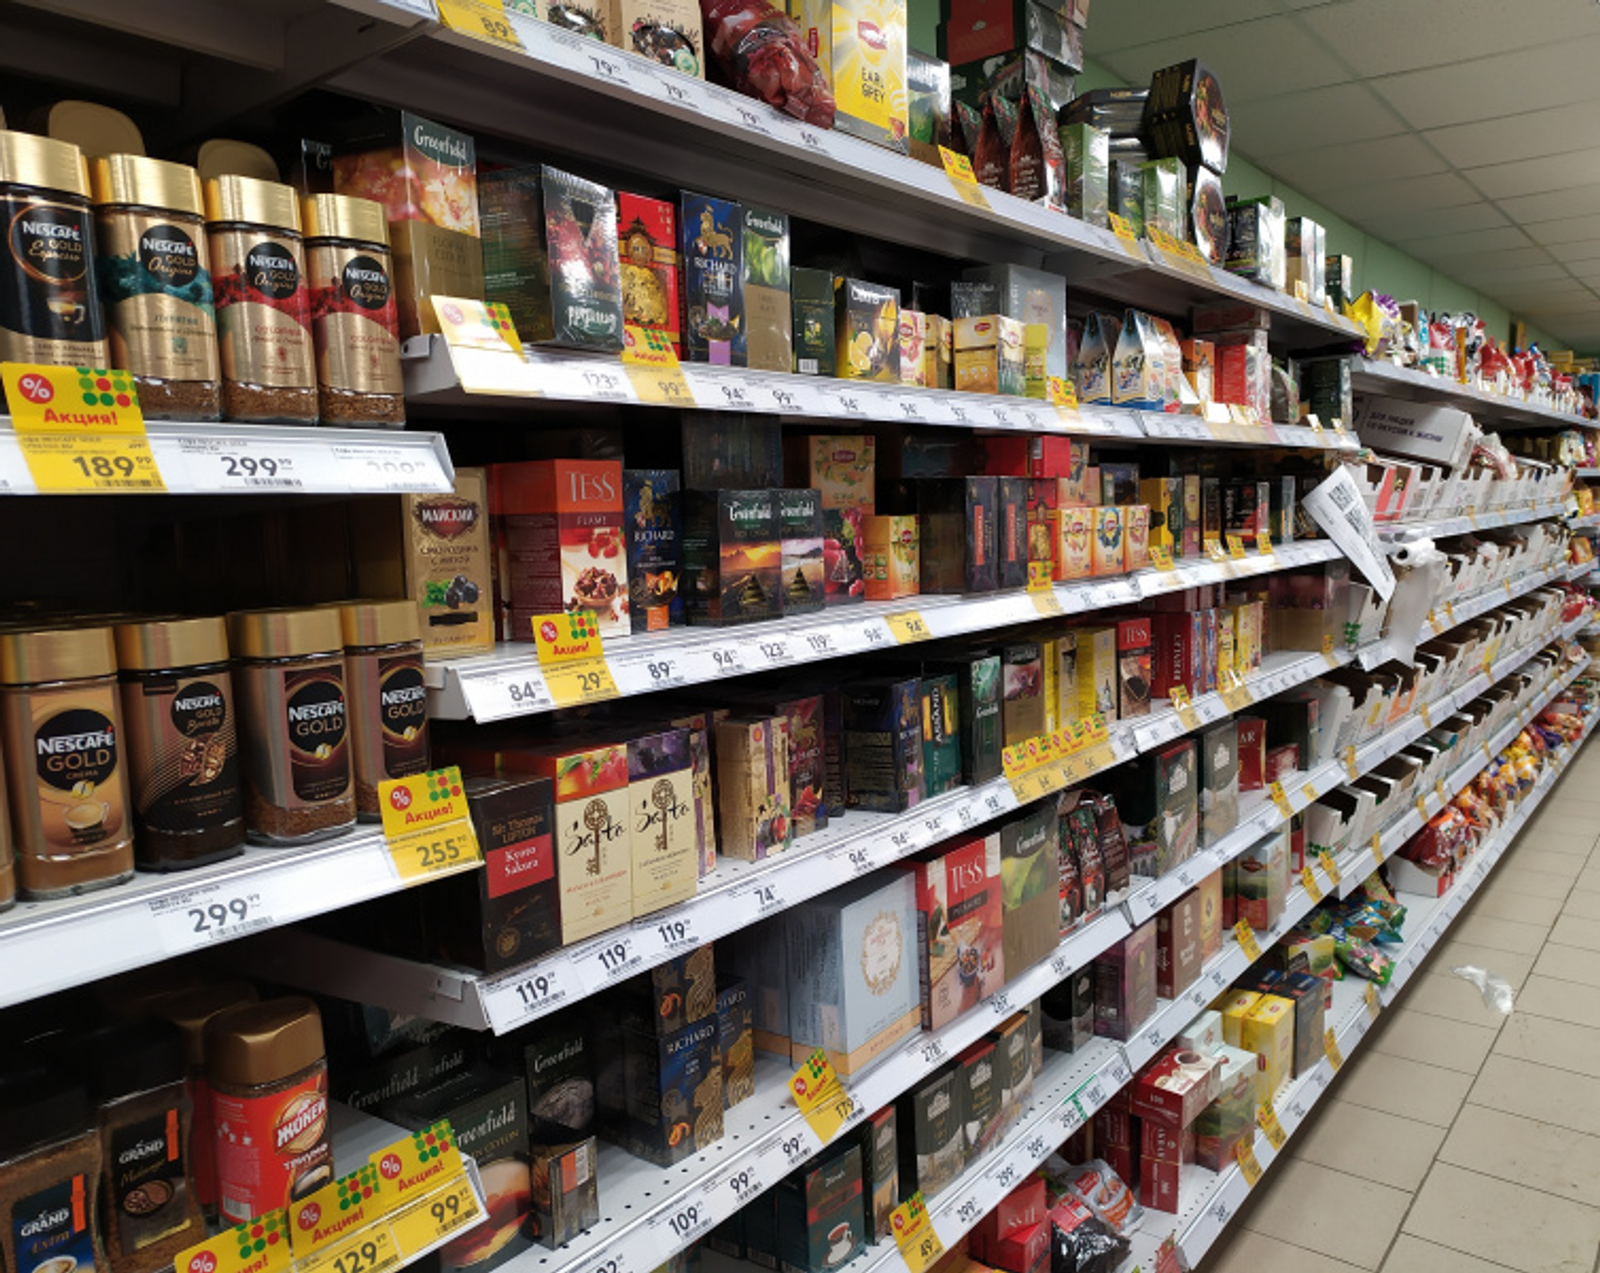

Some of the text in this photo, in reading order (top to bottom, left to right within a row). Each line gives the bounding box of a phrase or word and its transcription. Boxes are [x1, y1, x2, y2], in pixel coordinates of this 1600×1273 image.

[862, 83, 886, 104] GREY
[414, 125, 467, 160] Greenfield
[22, 220, 80, 241] NESCAFÉ
[48, 239, 82, 252] GOLD
[142, 237, 193, 256] NESCAFÉ
[166, 254, 196, 267] GOLD
[694, 256, 737, 275] RICHARD
[44, 407, 118, 426] Акция!
[73, 456, 135, 477] 189
[221, 456, 278, 476] 299
[565, 470, 615, 502] TESS
[422, 507, 474, 523] МАЙСКИЙ
[577, 516, 607, 525] FLAME
[712, 651, 733, 667] 94
[577, 672, 600, 691] 29
[647, 661, 670, 680] 89
[175, 691, 221, 711] NESCAFÉ
[509, 682, 535, 702] 84
[196, 707, 223, 719] GOLD
[388, 702, 426, 719] GOLD
[297, 716, 343, 736] GOLD
[37, 725, 115, 754] NESCAFÉ
[46, 749, 110, 771] GOLD
[66, 768, 99, 780] CREMA
[405, 802, 454, 825] Акция!
[415, 839, 460, 867] 255
[504, 858, 539, 877] Sakura
[950, 856, 984, 894] TESS
[753, 886, 774, 906] 74
[188, 897, 249, 933] 299
[658, 921, 685, 943] 119
[598, 943, 626, 970] 119
[516, 976, 548, 1003] 119
[666, 1024, 715, 1054] RICHARD
[534, 1036, 583, 1073] Greenfield
[348, 1065, 419, 1109] Greenfield
[452, 1101, 515, 1147] reenfield
[119, 1138, 164, 1164] GRAND
[783, 1136, 800, 1158] 99
[398, 1158, 446, 1192] Акция!
[730, 1171, 748, 1194] 99
[430, 1193, 460, 1224] 99
[21, 1208, 70, 1237] GRAND
[311, 1206, 365, 1244] Акция!
[668, 1206, 698, 1236] 109
[31, 1230, 70, 1255] Extra
[333, 1240, 378, 1273] 129
